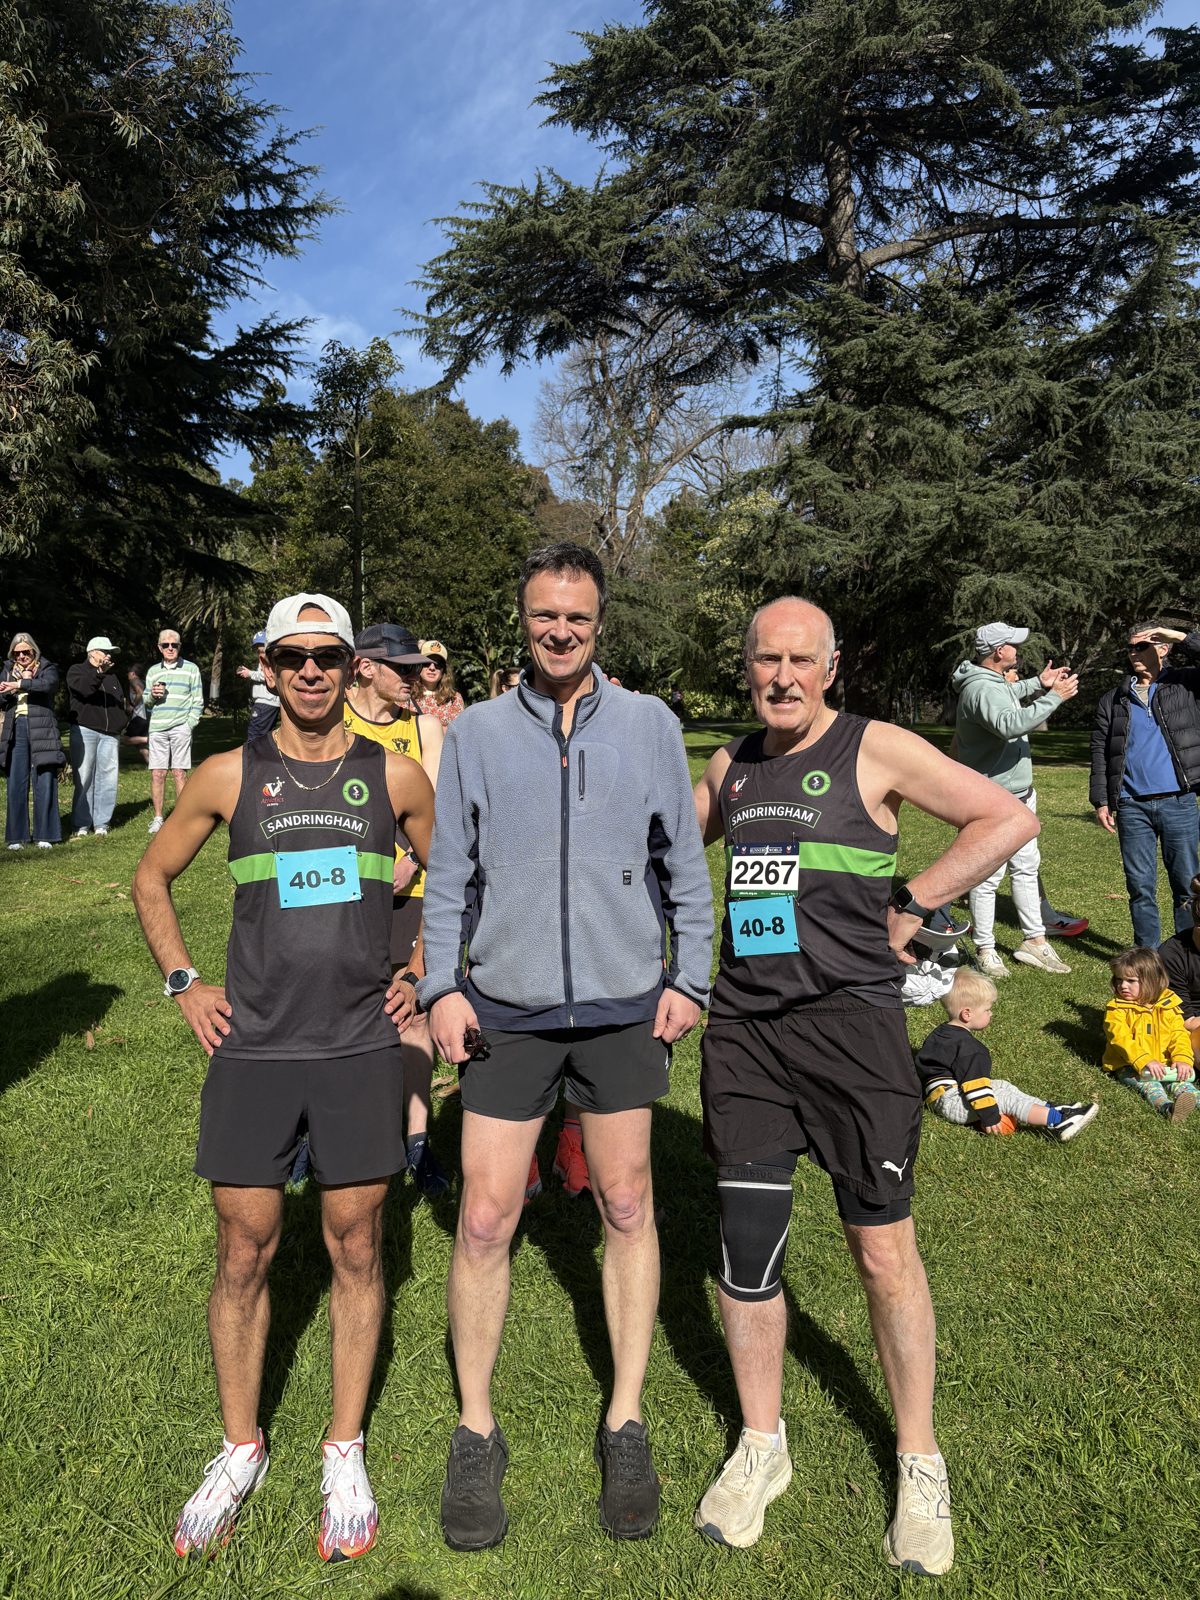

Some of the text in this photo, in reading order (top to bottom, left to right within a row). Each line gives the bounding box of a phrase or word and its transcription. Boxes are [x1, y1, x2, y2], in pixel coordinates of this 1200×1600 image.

[266, 814, 363, 833] SANDRINGHAM
[731, 806, 814, 826] SANDRINGHAM
[289, 867, 346, 890] 40-8
[733, 860, 797, 886] 2267
[739, 916, 785, 938] 40-8
